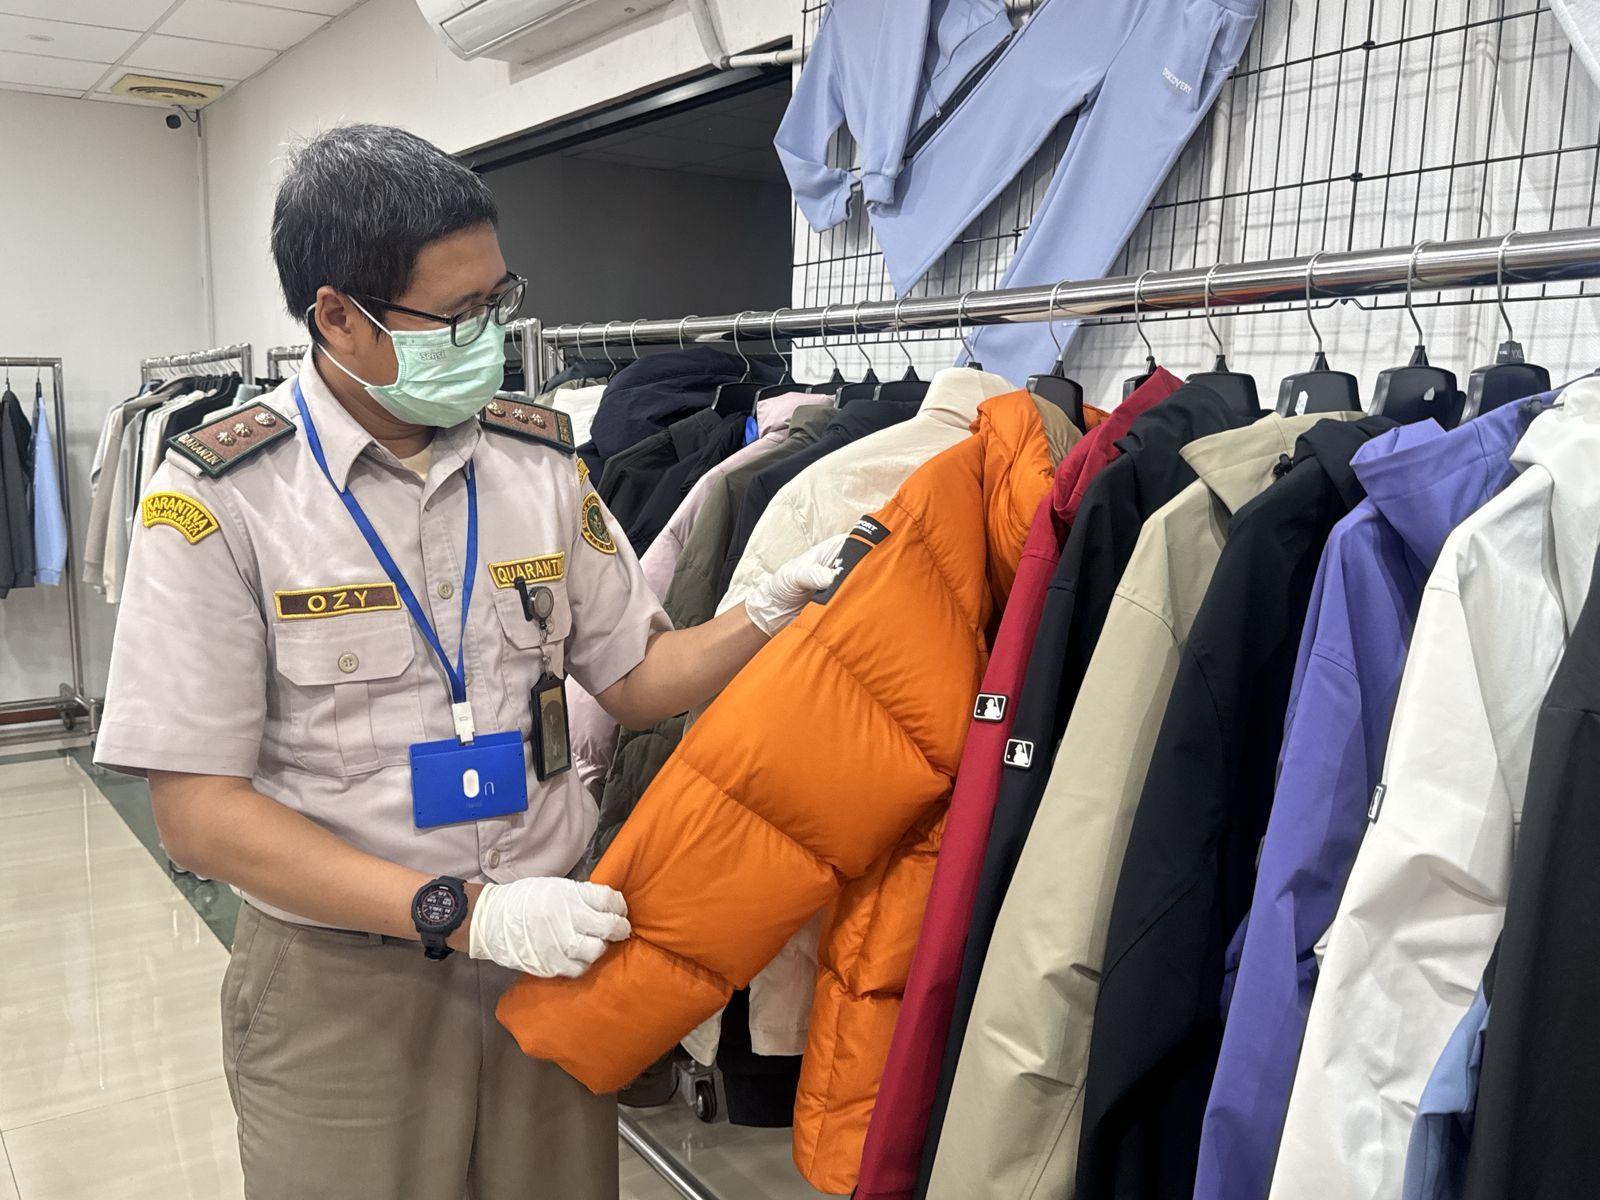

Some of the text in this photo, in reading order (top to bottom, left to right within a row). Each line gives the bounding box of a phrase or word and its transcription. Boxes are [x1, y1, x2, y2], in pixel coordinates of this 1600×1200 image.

[146, 496, 208, 531] KARANTINA
[161, 510, 199, 536] JAKARTA
[307, 590, 368, 612] OZY
